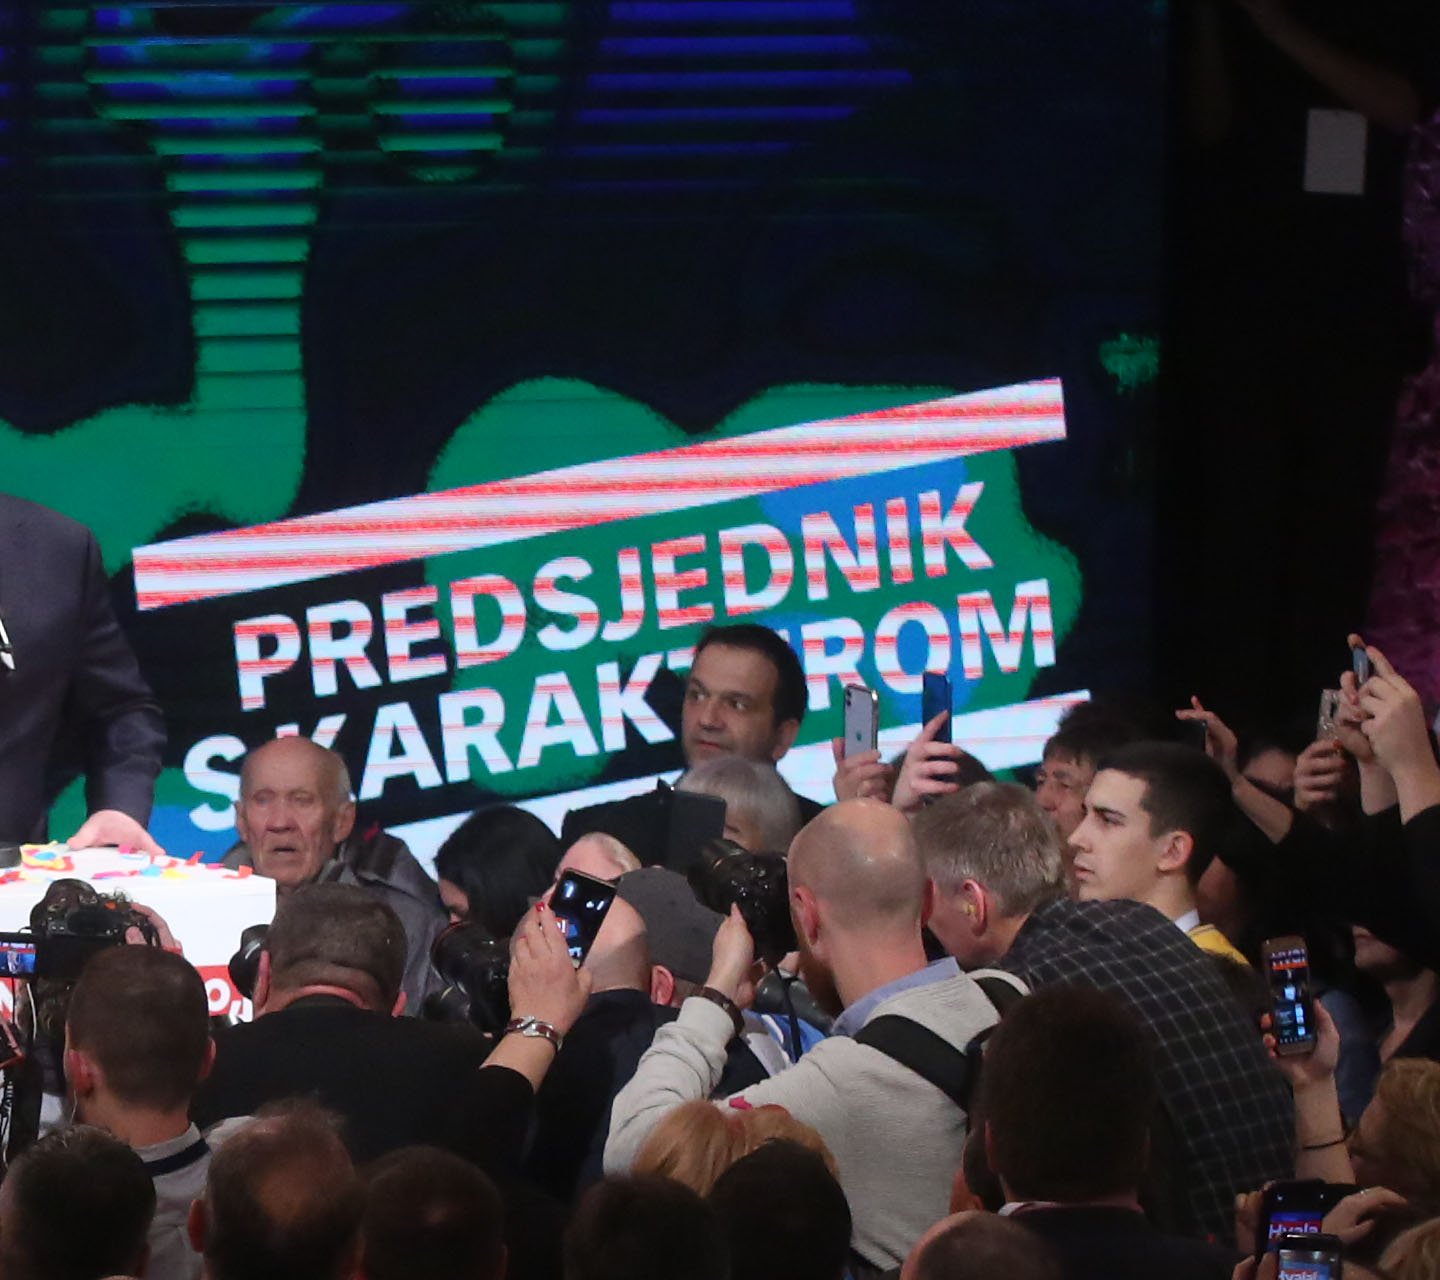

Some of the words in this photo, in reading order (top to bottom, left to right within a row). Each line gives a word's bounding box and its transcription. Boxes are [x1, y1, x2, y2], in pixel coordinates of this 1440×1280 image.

[182, 733, 247, 832] S
[276, 577, 1056, 803] ARAKROM
[233, 481, 994, 712] PREDSJEDNIK
